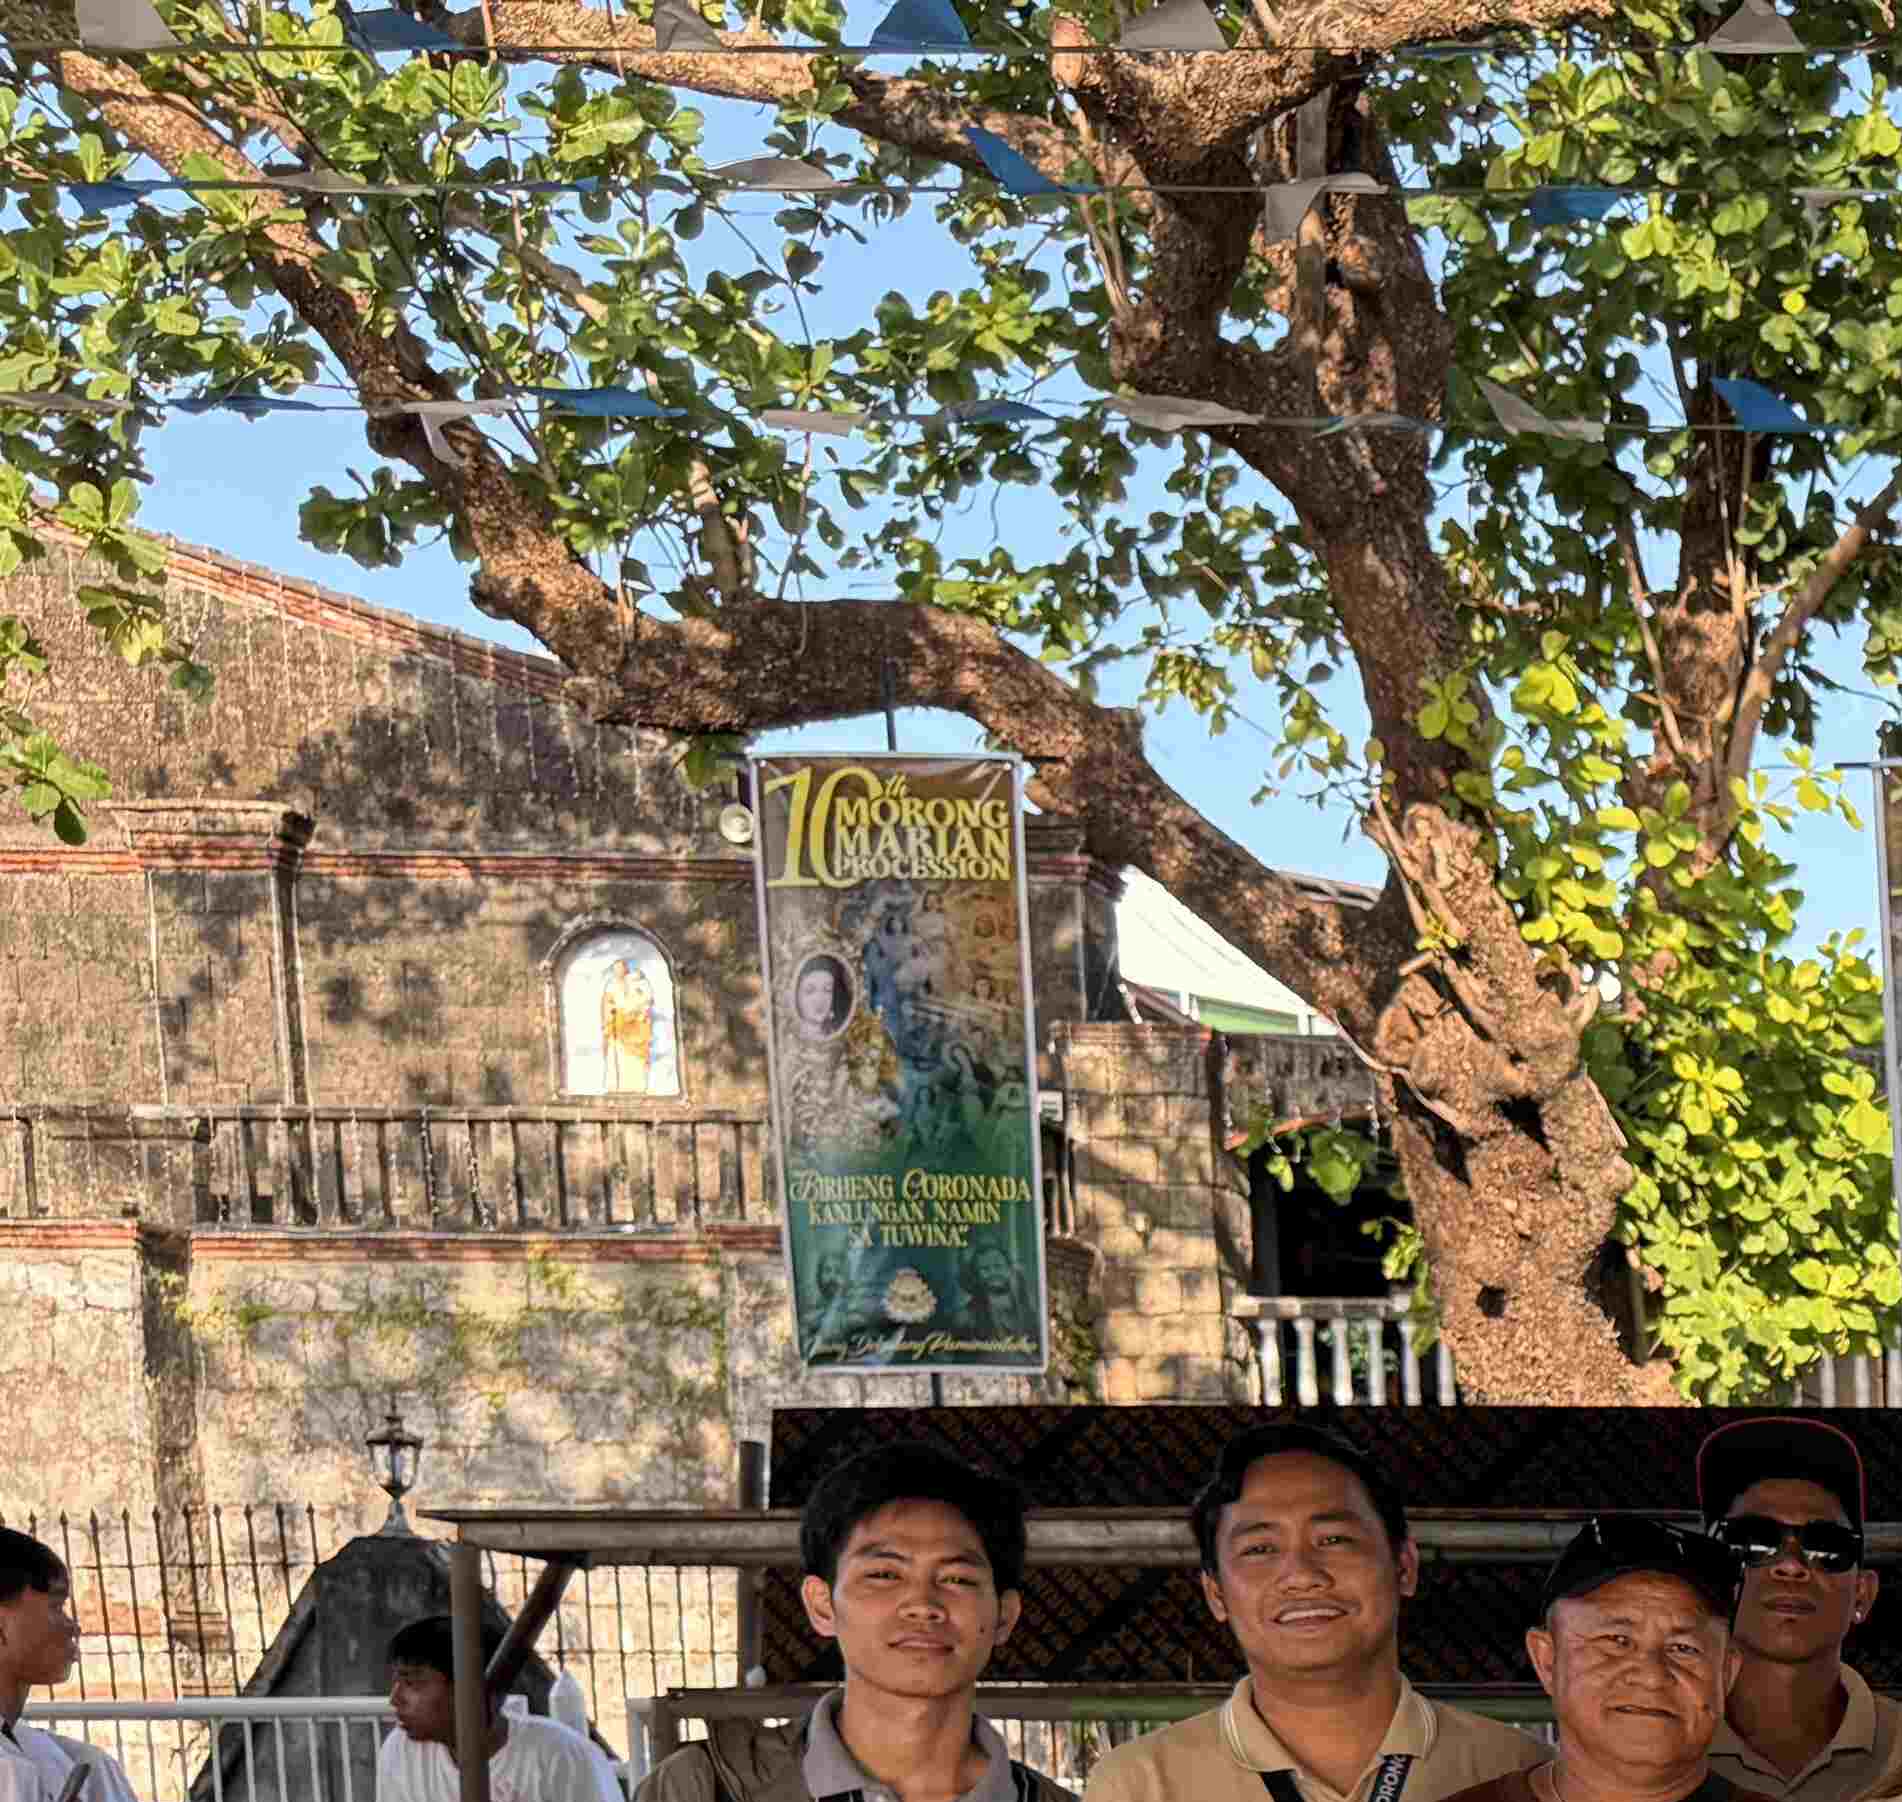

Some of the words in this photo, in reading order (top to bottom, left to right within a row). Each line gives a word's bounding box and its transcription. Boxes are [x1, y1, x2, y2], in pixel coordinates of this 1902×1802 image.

[834, 797, 1009, 830] MORONG
[834, 826, 1010, 860] MARIAN
[834, 856, 1010, 881] PROCESSION
